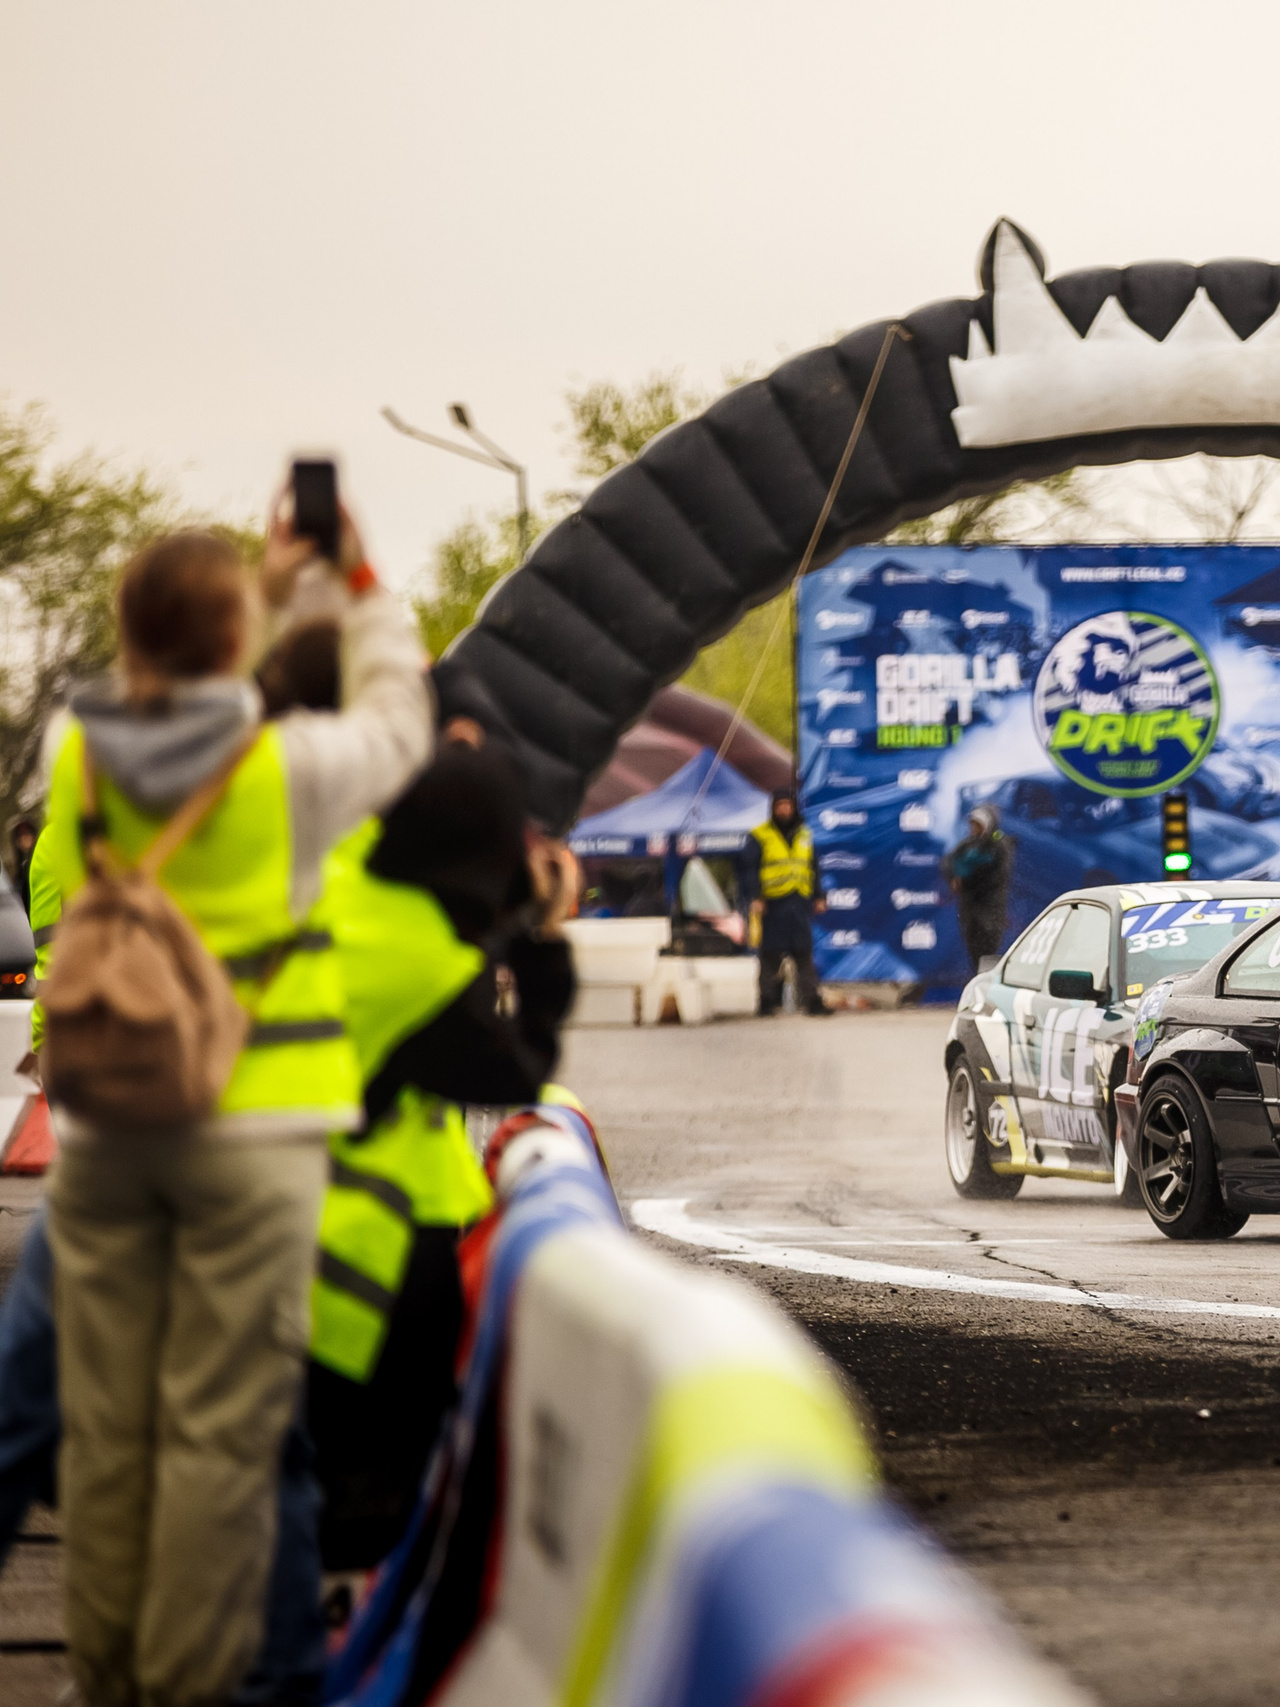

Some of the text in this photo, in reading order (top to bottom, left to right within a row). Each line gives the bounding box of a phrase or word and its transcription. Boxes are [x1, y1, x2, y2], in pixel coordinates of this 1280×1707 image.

[876, 654, 1022, 690] GORILLA
[876, 689, 974, 726] DRIFT
[877, 724, 949, 748] ROUND
[1051, 708, 1204, 756] DRIFT
[1127, 927, 1189, 954] 333
[1038, 1007, 1107, 1107] ICE
